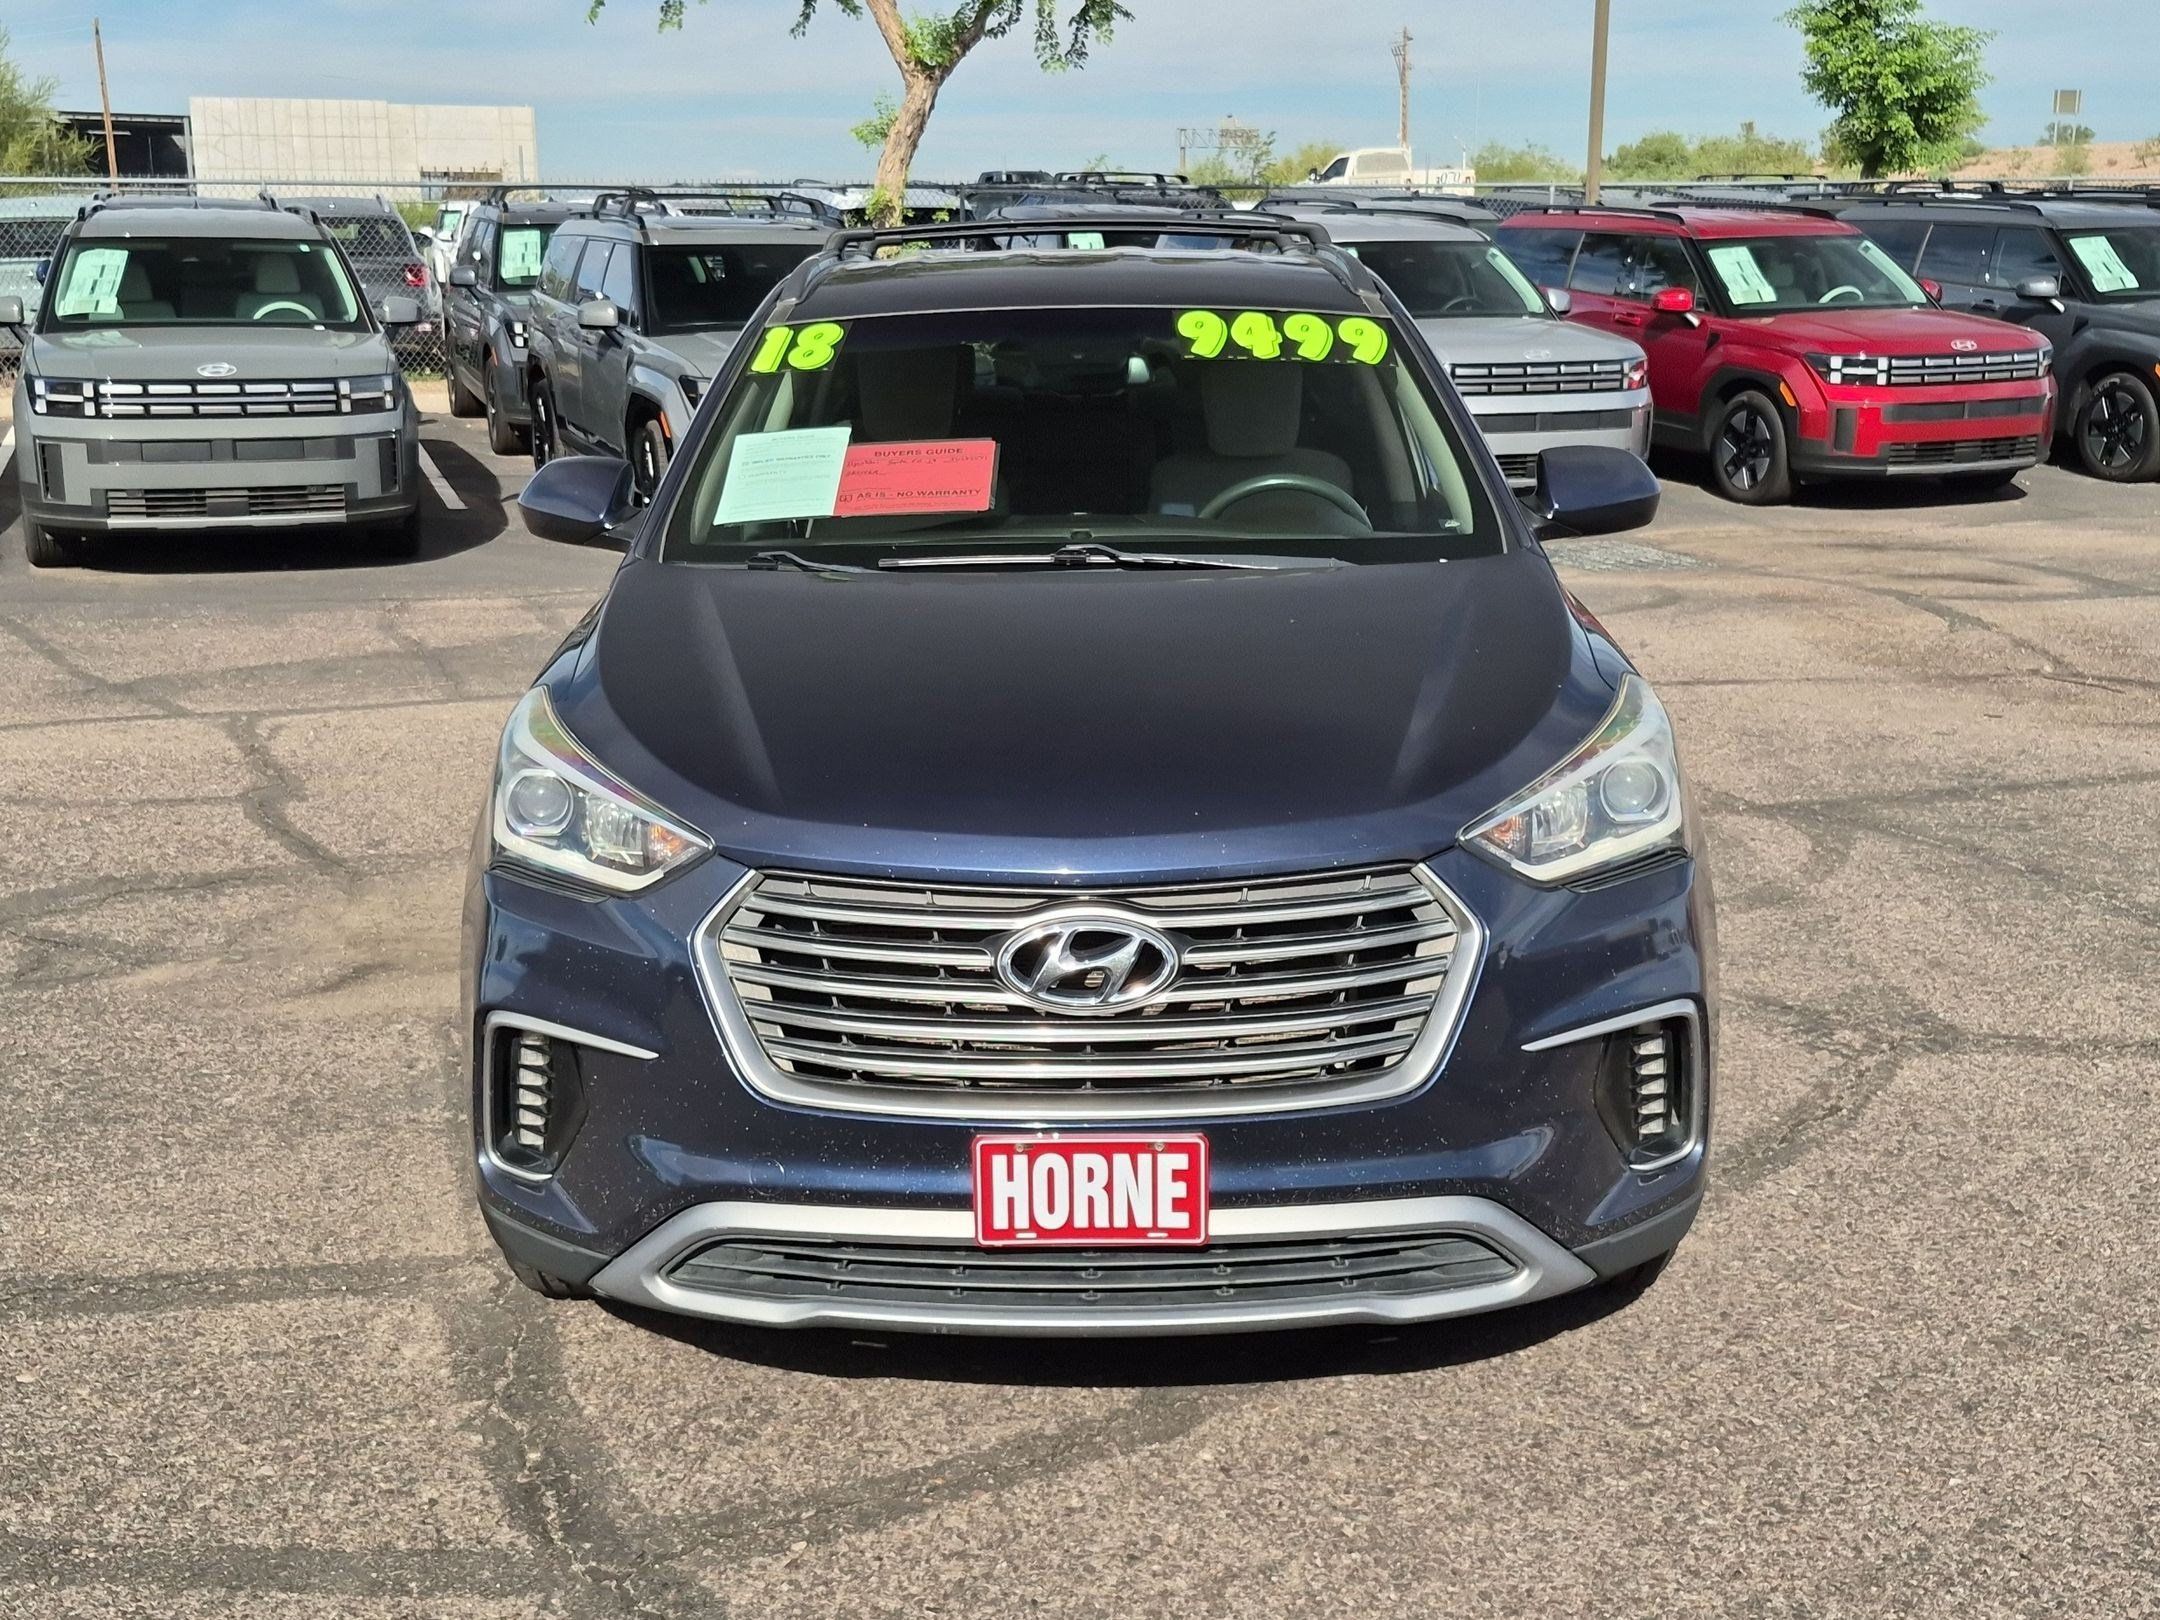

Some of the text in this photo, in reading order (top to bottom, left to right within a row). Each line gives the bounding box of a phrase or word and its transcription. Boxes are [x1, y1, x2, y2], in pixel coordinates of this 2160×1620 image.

[750, 322, 845, 374] 18
[1177, 310, 1389, 365] 9499
[926, 447, 963, 455] GUIDE
[991, 1152, 1191, 1230] HORNE
